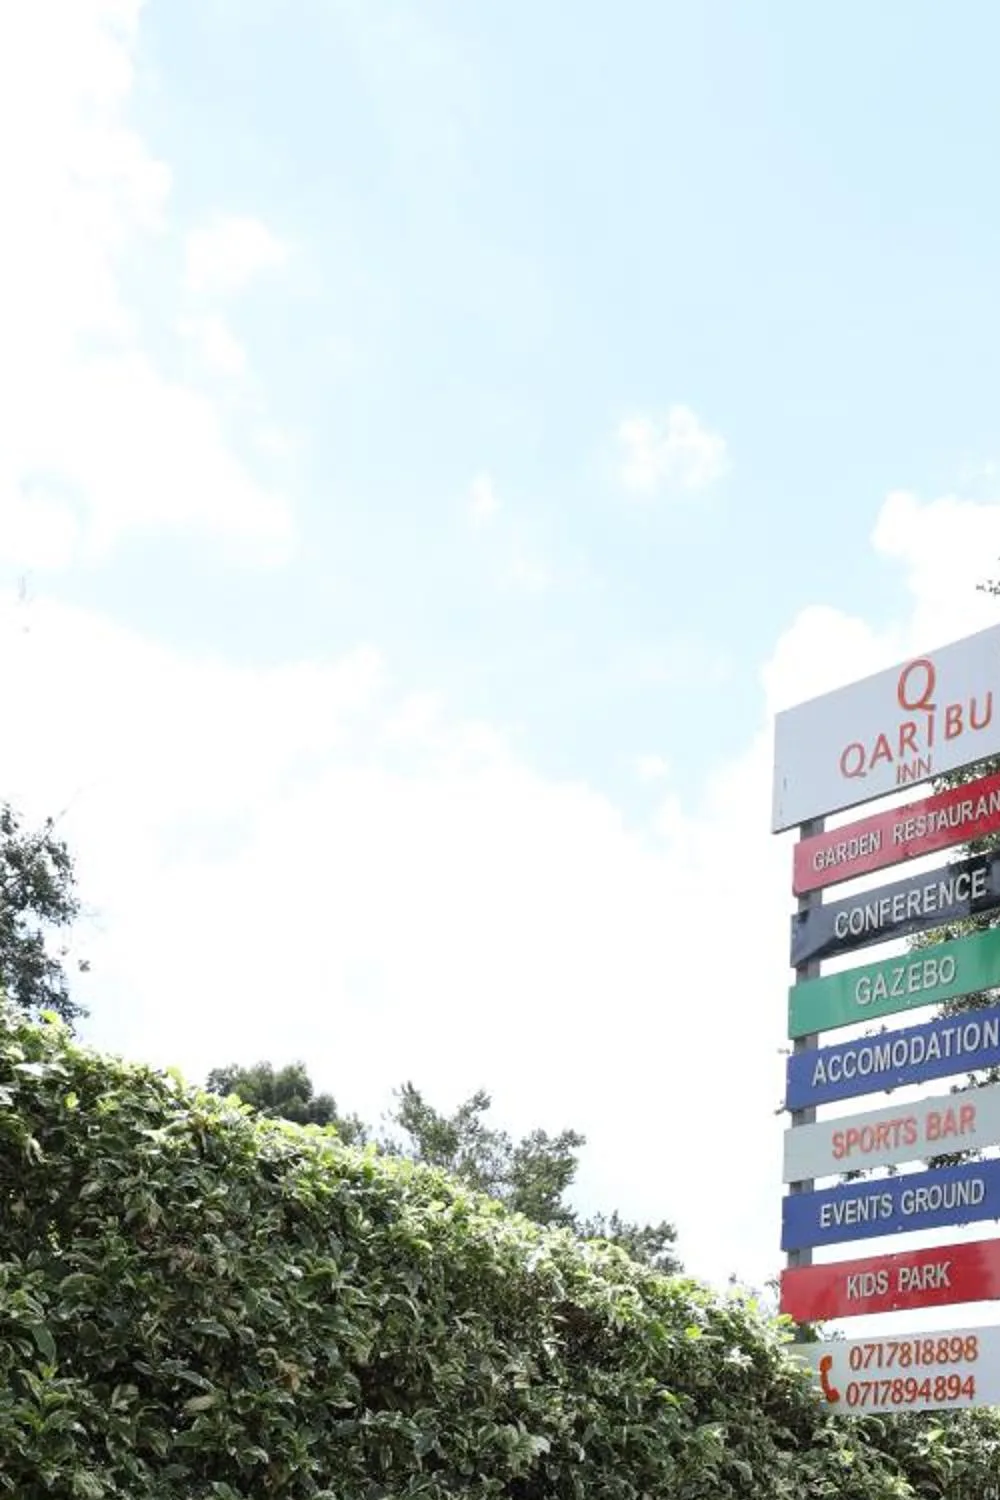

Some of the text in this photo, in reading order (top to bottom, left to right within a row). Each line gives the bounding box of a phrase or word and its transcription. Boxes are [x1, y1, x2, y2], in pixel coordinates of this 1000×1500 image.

[897, 658, 937, 711] Q
[838, 690, 994, 779] QARIBU
[896, 752, 932, 784] INN
[812, 831, 881, 872] GARDEN
[834, 867, 987, 939] CONFERENCE
[854, 954, 957, 1005] GAZEBO
[812, 1019, 1000, 1087] ACCOMODATION
[831, 1103, 977, 1160] SPORTS BAR
[819, 1179, 986, 1228] EVENTS GROUND
[846, 1261, 952, 1299] KIDS PARK
[848, 1335, 979, 1371] 0717818898
[845, 1374, 976, 1407] 0717894894
